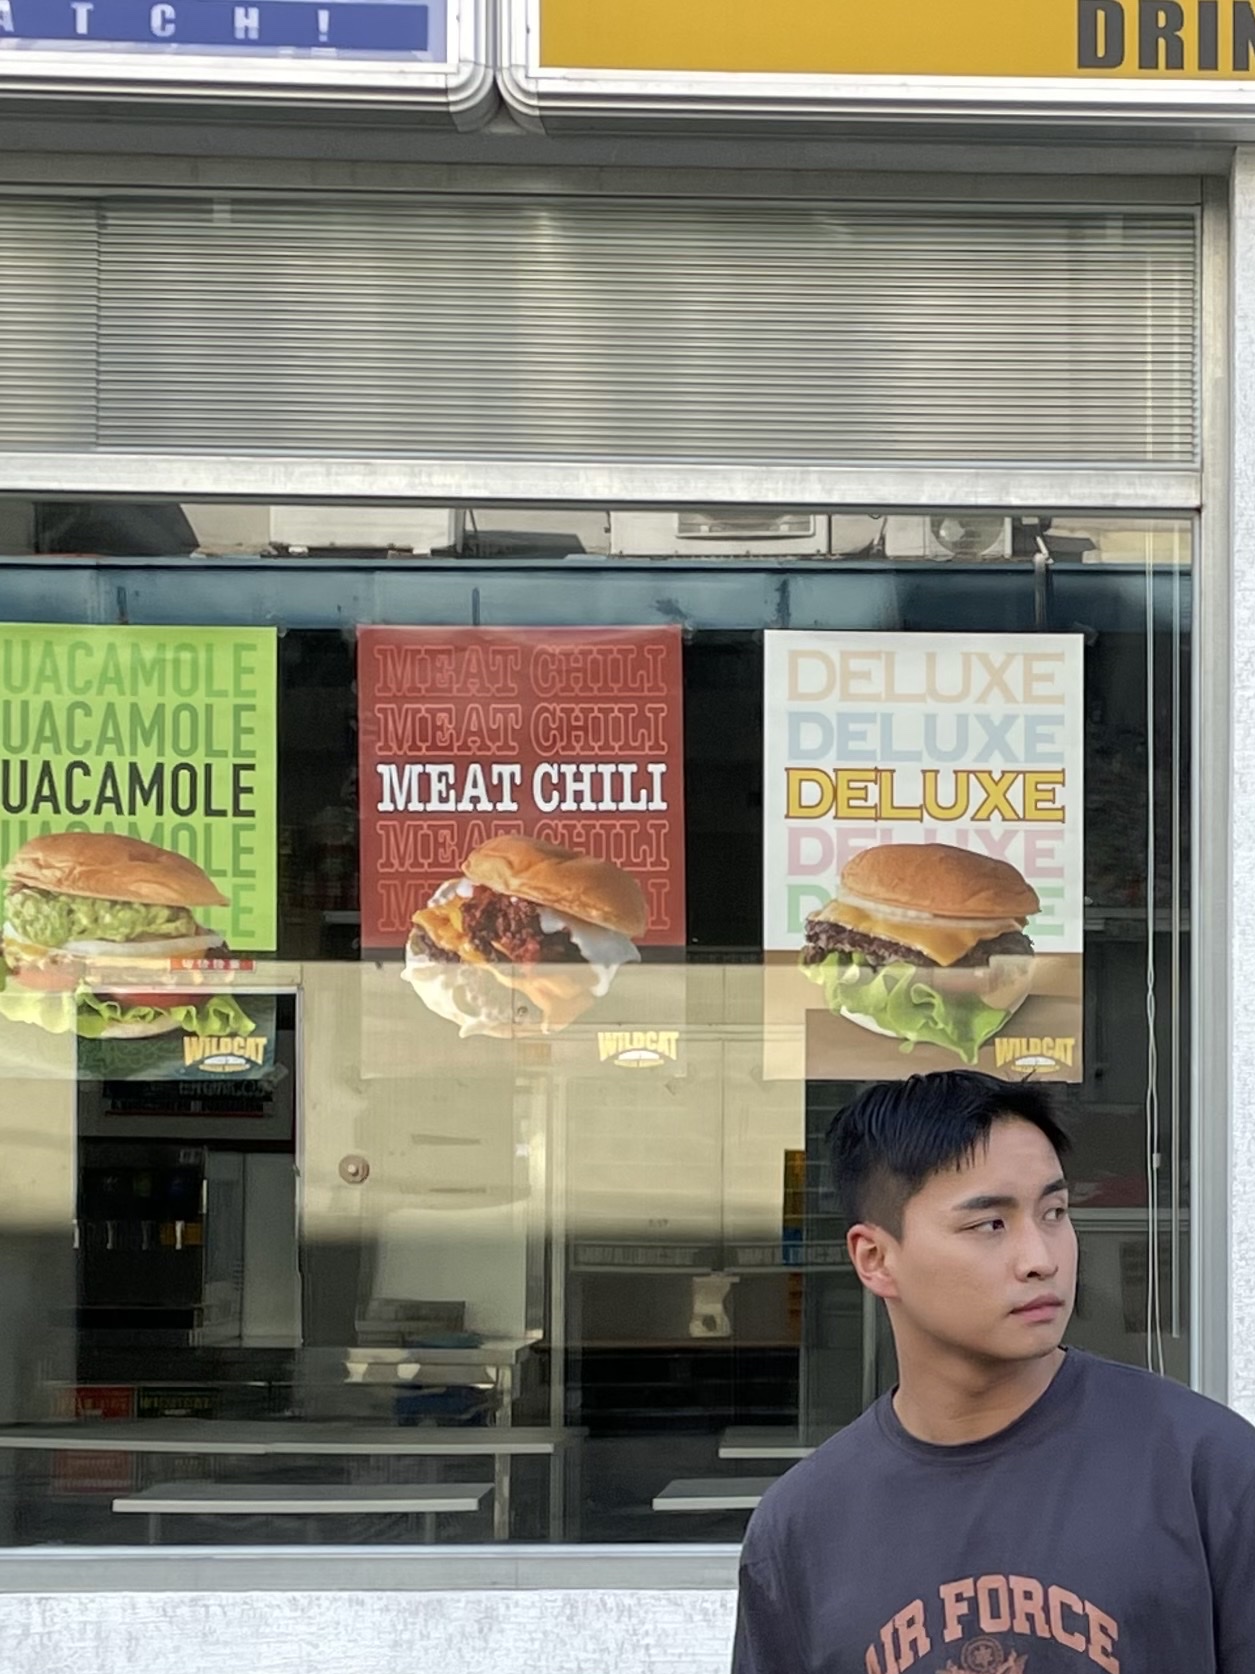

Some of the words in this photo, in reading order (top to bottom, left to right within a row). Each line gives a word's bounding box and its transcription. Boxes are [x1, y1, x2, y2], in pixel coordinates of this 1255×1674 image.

[2, 639, 257, 699] UACAMOLE
[374, 644, 522, 697] MEAT
[530, 644, 667, 697] CHILI
[787, 649, 1065, 705] DELUXE
[1, 700, 257, 759] UACAMOLE
[375, 703, 522, 756] MEAT
[530, 703, 668, 756] CHILI
[786, 711, 1065, 764] DELUXE
[1, 759, 256, 818] UACAMOLE
[377, 762, 522, 813] MEAT
[532, 762, 668, 813] CHILI
[785, 767, 1066, 824] DELUXE
[183, 1036, 267, 1067] WILDCAT
[597, 1031, 680, 1062] WILDCAT
[994, 1036, 1076, 1068] WILDCAT
